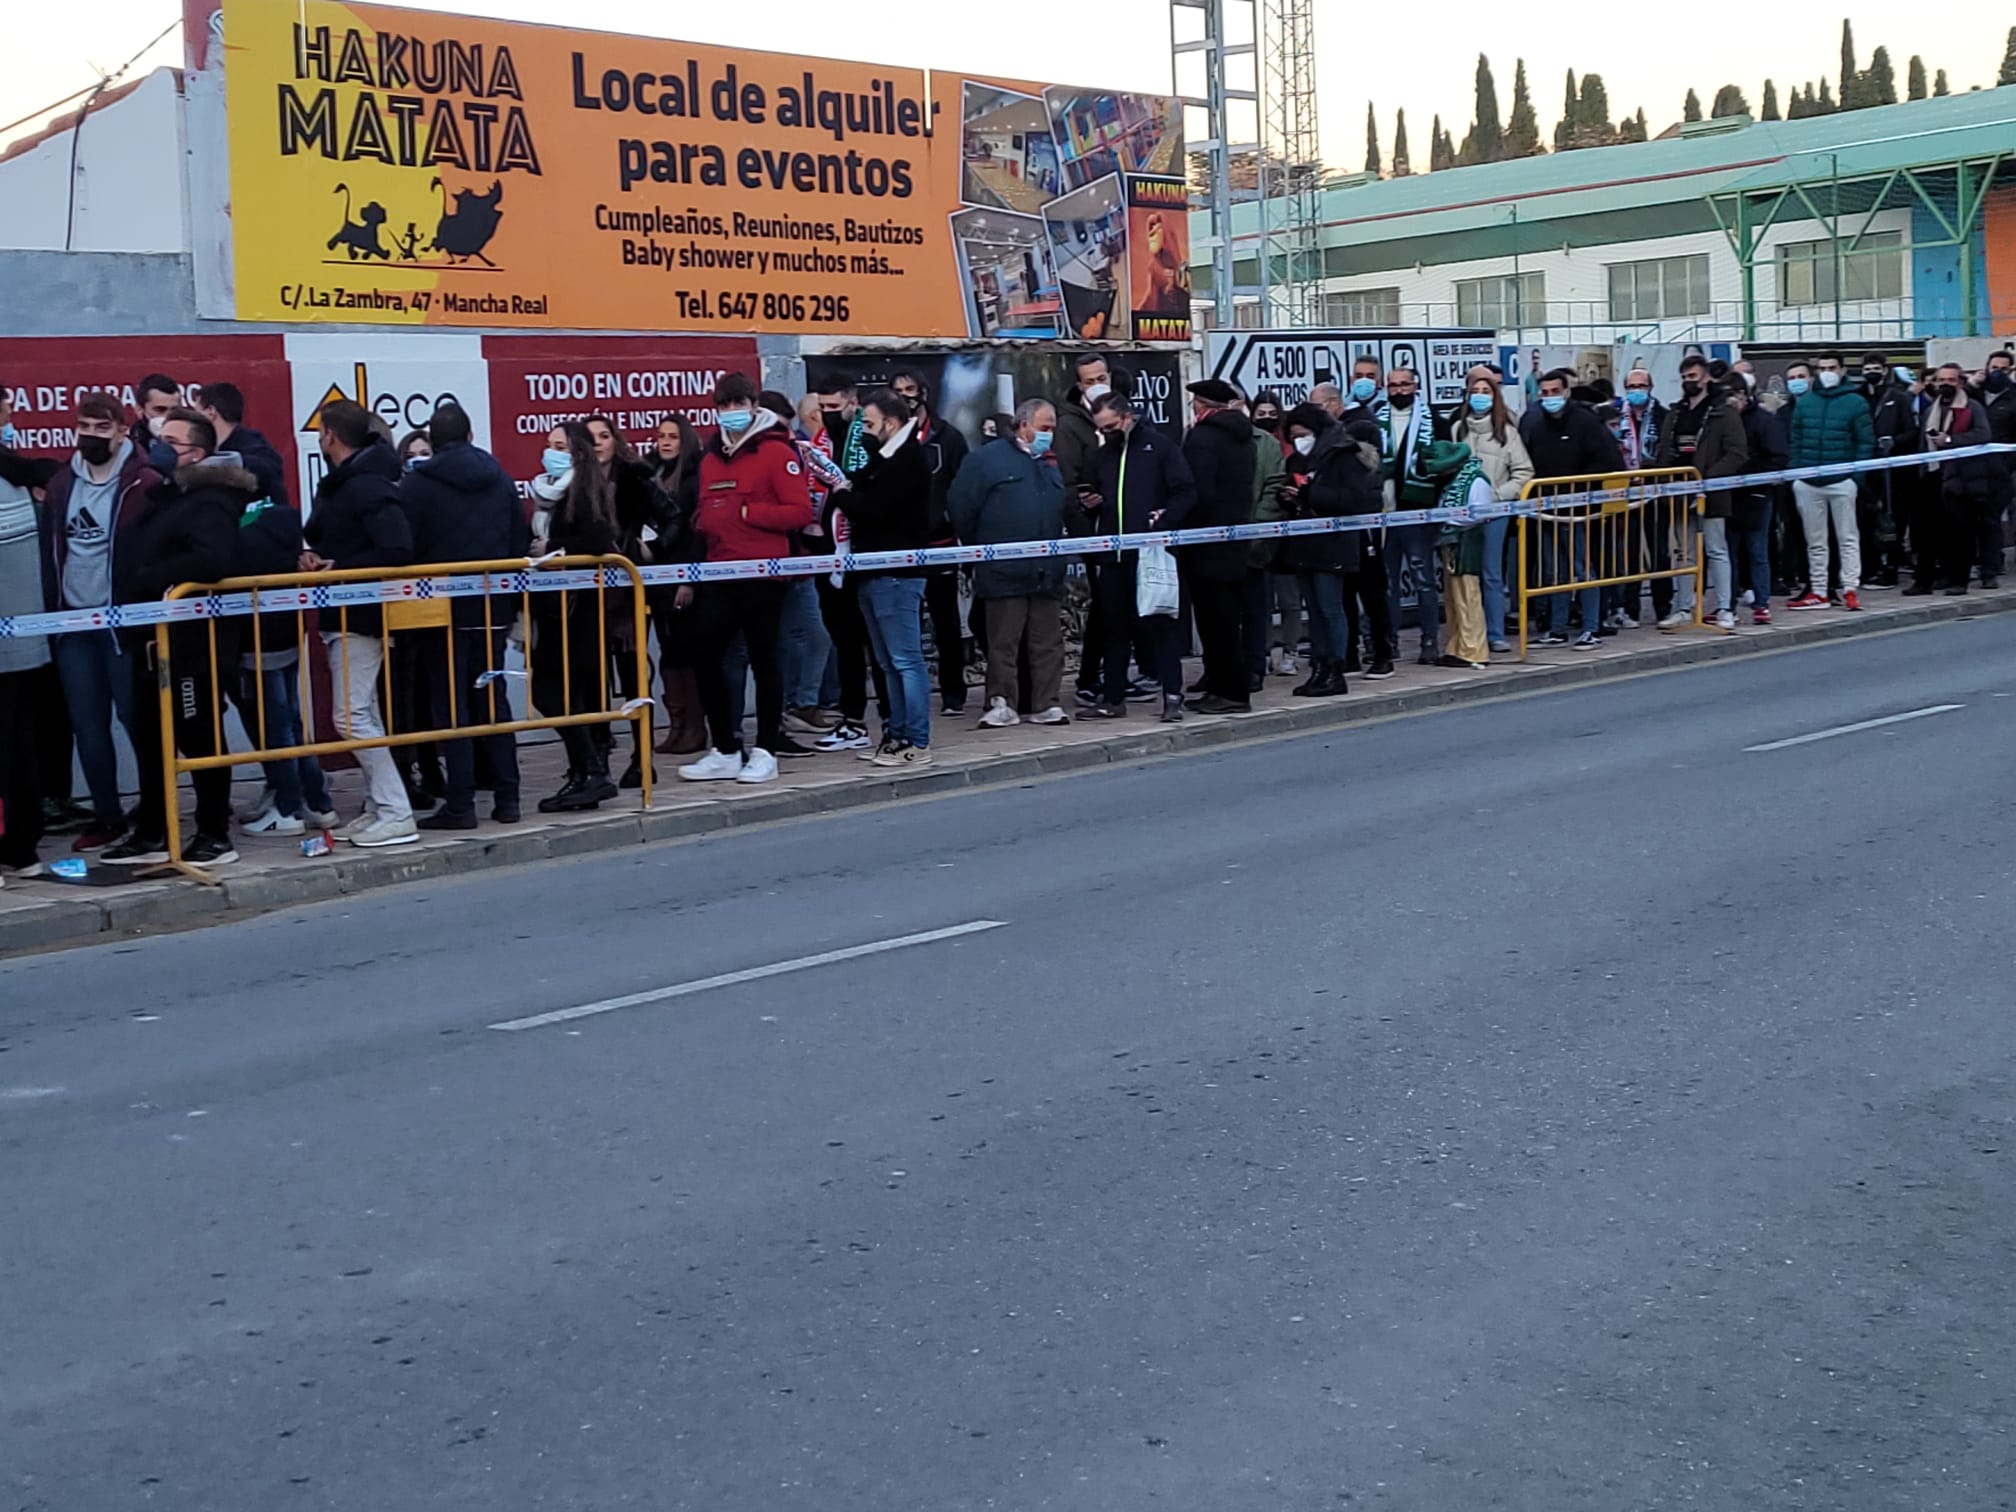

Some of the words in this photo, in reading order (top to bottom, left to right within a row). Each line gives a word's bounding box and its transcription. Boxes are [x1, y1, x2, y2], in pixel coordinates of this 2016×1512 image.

[294, 22, 523, 101] HAKUNA
[572, 52, 699, 118] Local
[711, 63, 766, 124] de
[776, 72, 940, 141] alquiler
[278, 83, 543, 176] MATATA
[619, 138, 726, 192] para
[737, 147, 913, 198] eventos
[594, 204, 729, 240] Cumpleaños,
[733, 212, 840, 245] Reuniones,
[845, 219, 923, 246] Bautizos
[622, 239, 675, 273] Baby
[679, 241, 753, 271] shower
[757, 250, 768, 275] y
[773, 248, 847, 274] muchos
[333, 286, 408, 314] Zambra,
[411, 291, 432, 312] 47
[443, 293, 510, 314] Mancha
[512, 294, 548, 315] Real
[675, 290, 714, 320] Tel.
[718, 293, 758, 320] 647
[763, 294, 805, 321] 806
[809, 295, 850, 322] 296
[1257, 346, 1270, 379] A
[1274, 345, 1306, 379] 500
[1434, 361, 1447, 380] LA
[36, 386, 69, 412] DE
[524, 373, 588, 401] TODO
[594, 372, 622, 399] EN
[618, 411, 628, 430] E
